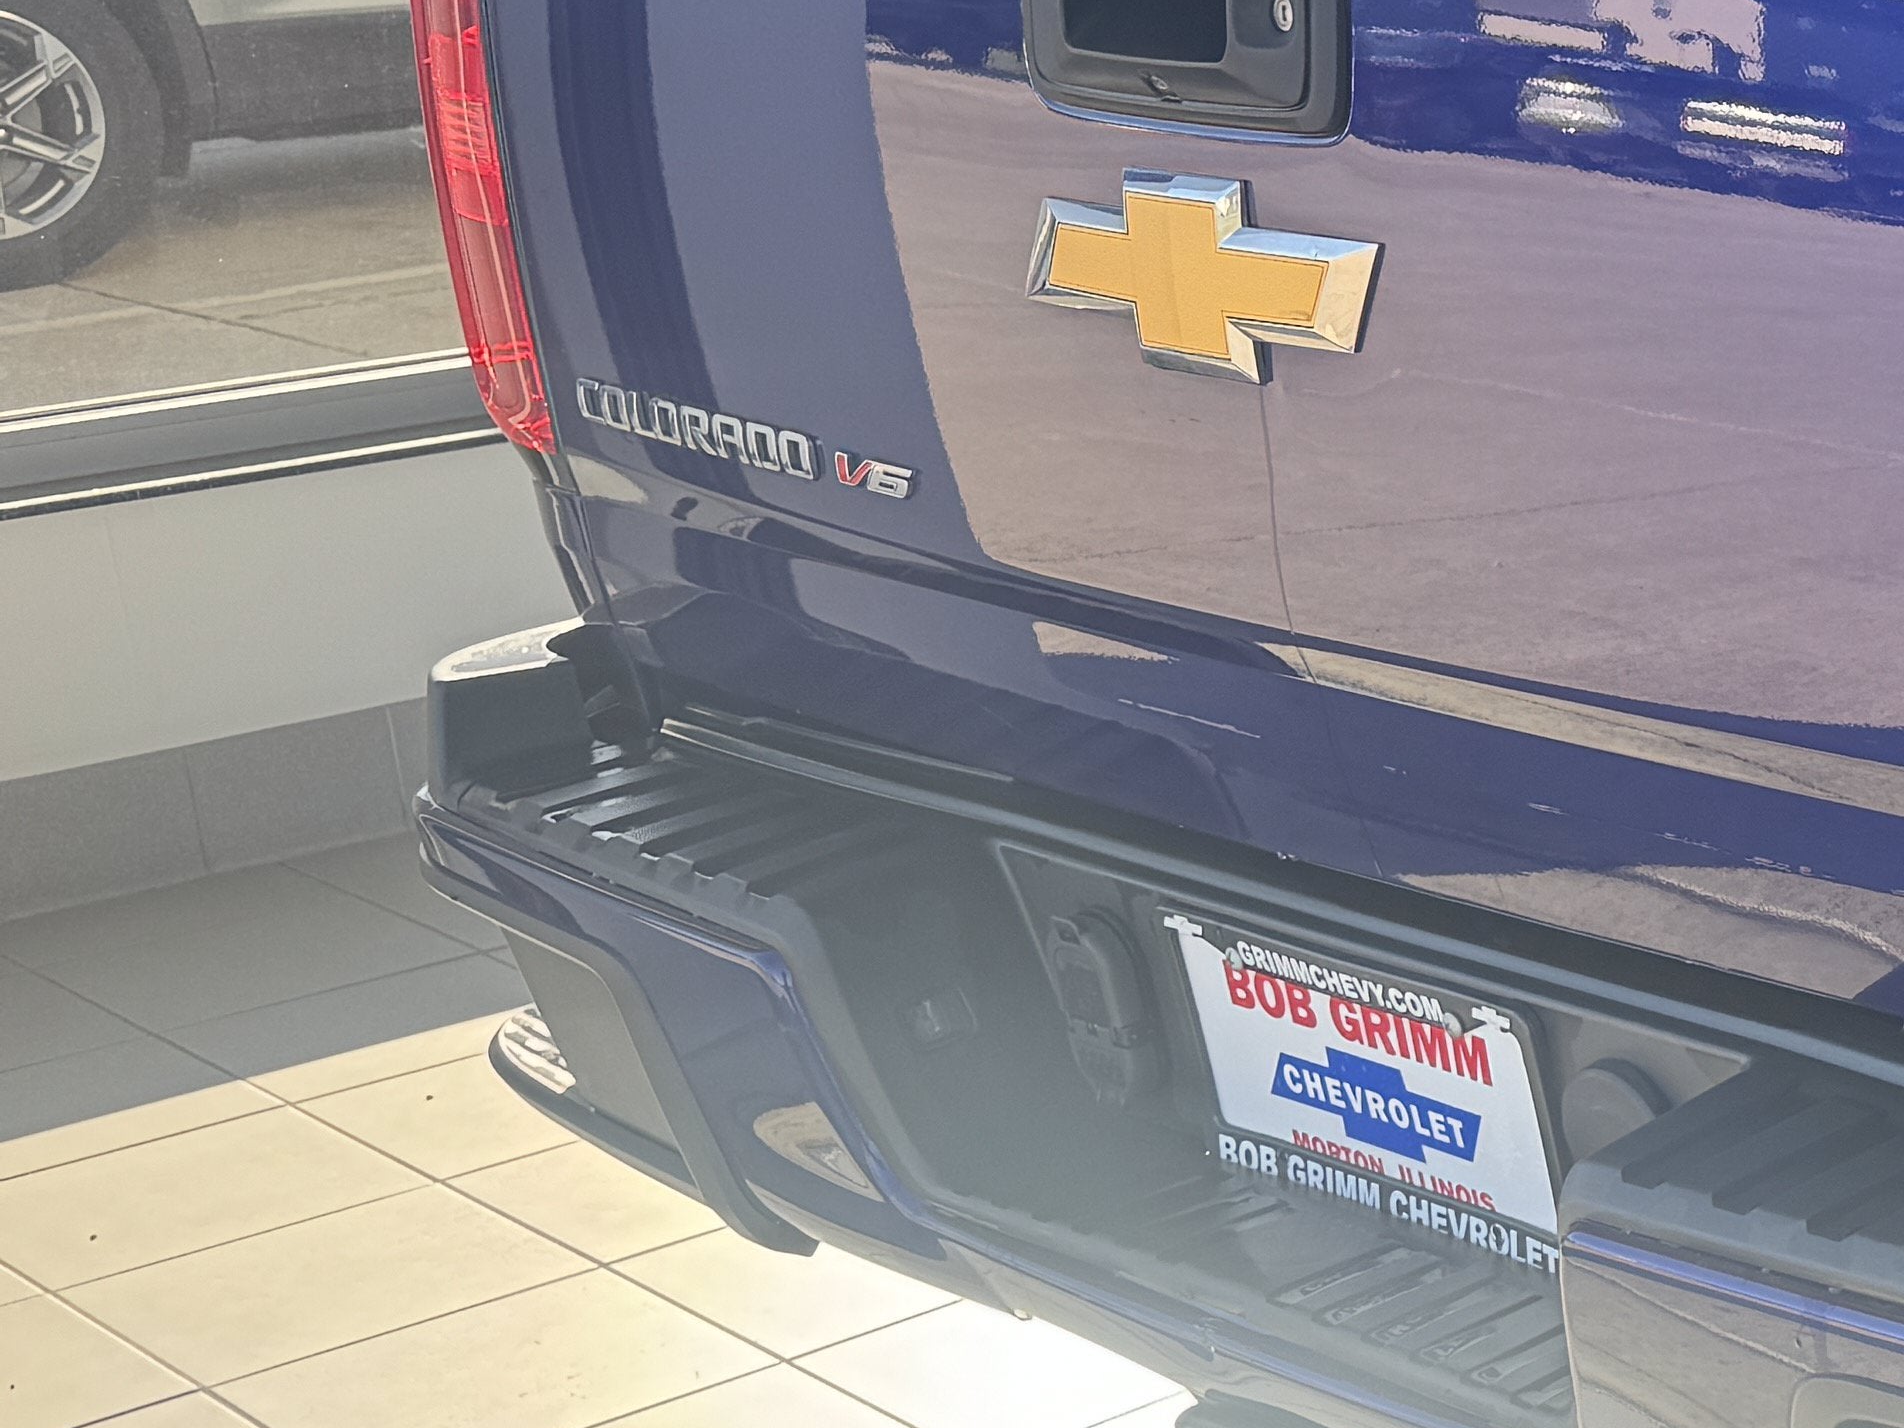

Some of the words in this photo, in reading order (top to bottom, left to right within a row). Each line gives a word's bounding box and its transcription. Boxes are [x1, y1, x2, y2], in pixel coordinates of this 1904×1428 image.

[576, 377, 818, 480] COLORADO
[833, 451, 915, 499] V6
[1223, 960, 1317, 1028] BOB
[1329, 997, 1493, 1086] GRIMM
[1236, 941, 1444, 1023] GRIMMCHEVY.COM
[1282, 1062, 1466, 1149] CHEVROLET
[1291, 1128, 1386, 1176] MORTON
[1218, 1133, 1278, 1177] BOB
[1286, 1154, 1381, 1211] GRIMM
[1389, 1190, 1559, 1273] CHEVROLET
